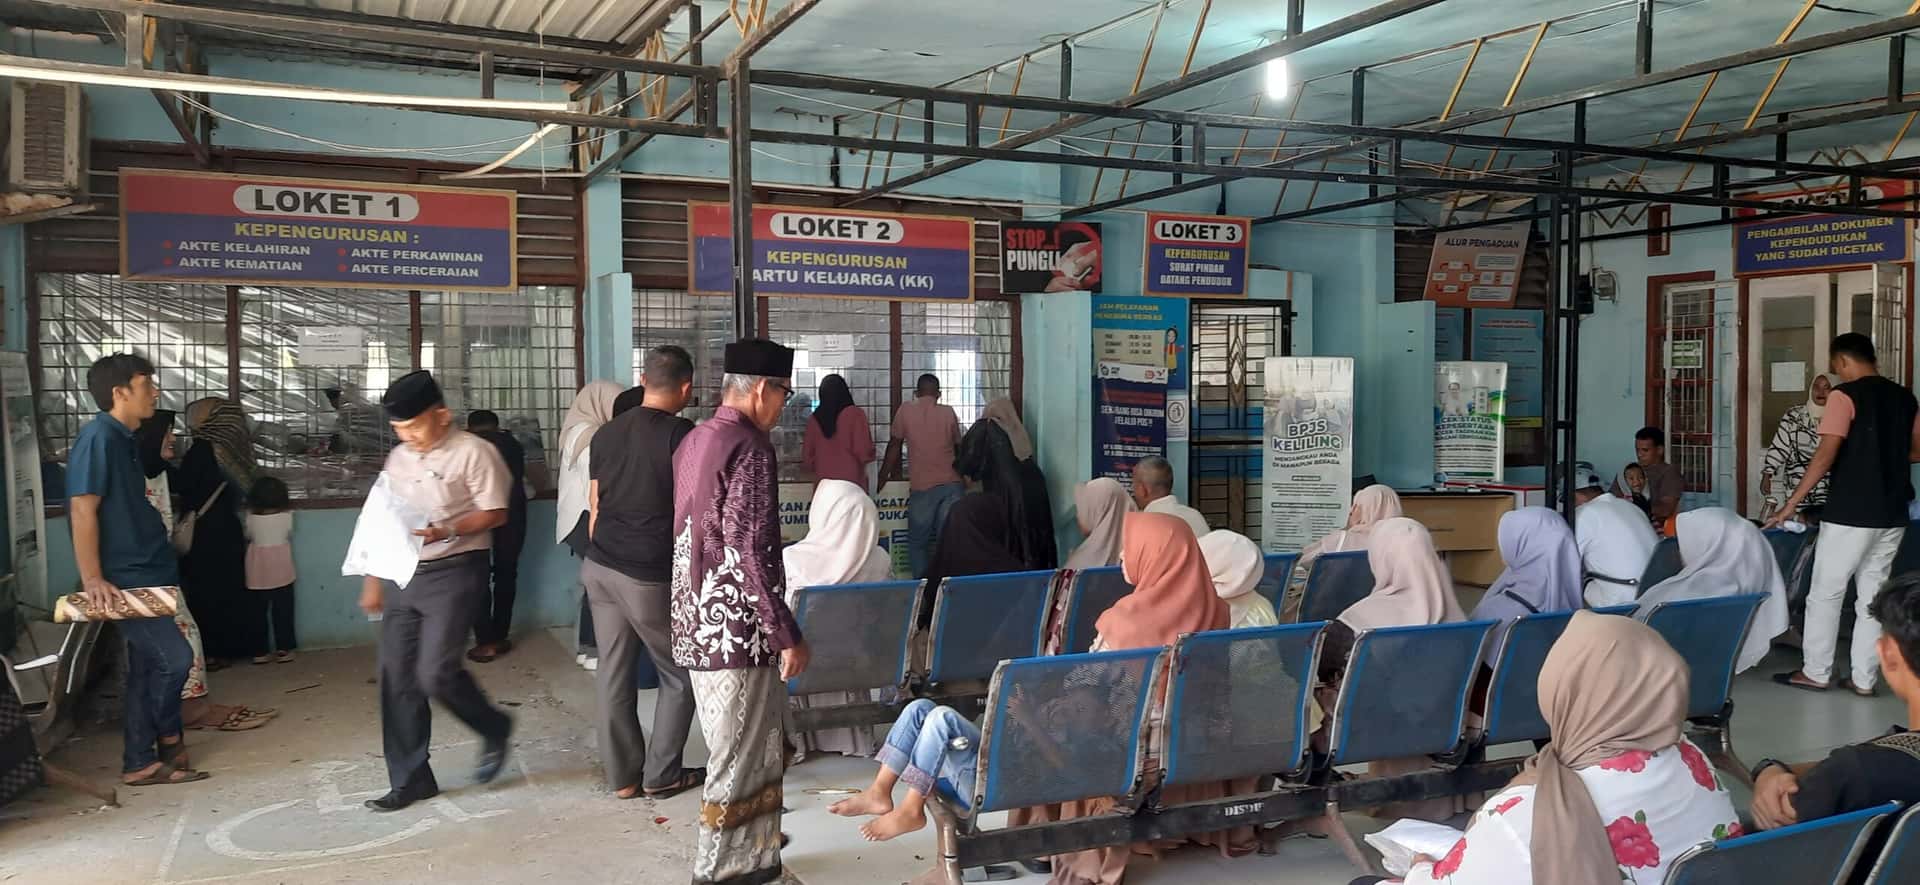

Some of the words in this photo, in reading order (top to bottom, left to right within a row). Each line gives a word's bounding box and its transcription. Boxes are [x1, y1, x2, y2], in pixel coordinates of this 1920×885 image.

[255, 189, 373, 216] LOKET
[385, 196, 400, 218] 1
[235, 222, 408, 243] KEPENGURUSAN
[783, 216, 868, 239] LOKET
[876, 222, 891, 240] 2
[1161, 222, 1220, 240] LOKET
[1226, 226, 1236, 241] 3
[1747, 224, 1829, 239] PENGAMBILAN
[1832, 217, 1894, 230] DOKUMEN
[178, 241, 221, 251] AKTE
[225, 243, 311, 255] KELAHIRAN
[1445, 238, 1467, 247] ALUR
[1469, 239, 1519, 248] PENGADUAN
[1770, 232, 1867, 248] KEPENDUDUKAN
[351, 248, 390, 259] AKTE
[393, 250, 484, 262] PERKAWINAN
[767, 250, 908, 269] KEPENGURUSAN
[1007, 249, 1061, 271] PUNGLI
[1165, 248, 1230, 260] KEPENGURUSAN
[1755, 251, 1786, 262] YANG
[1788, 248, 1828, 258] SUDAH
[1832, 243, 1885, 255] DICETAK
[178, 257, 221, 268] AKTE
[225, 259, 303, 271] KEMATIAN
[351, 264, 390, 275] AKTE
[393, 266, 480, 278] PERCERAIAN
[1169, 262, 1195, 272] SURAT
[1196, 263, 1224, 273] PINDAH
[752, 268, 798, 283] ARTU
[804, 271, 895, 287] KELUARGA
[900, 274, 934, 291] (KK)
[1160, 275, 1190, 285] DATANG
[1192, 276, 1232, 286] PENDUDUK
[1288, 420, 1327, 437] BPJS
[1272, 436, 1342, 452] KELILING
[779, 501, 803, 512] KAN
[879, 510, 910, 520] DUKA
